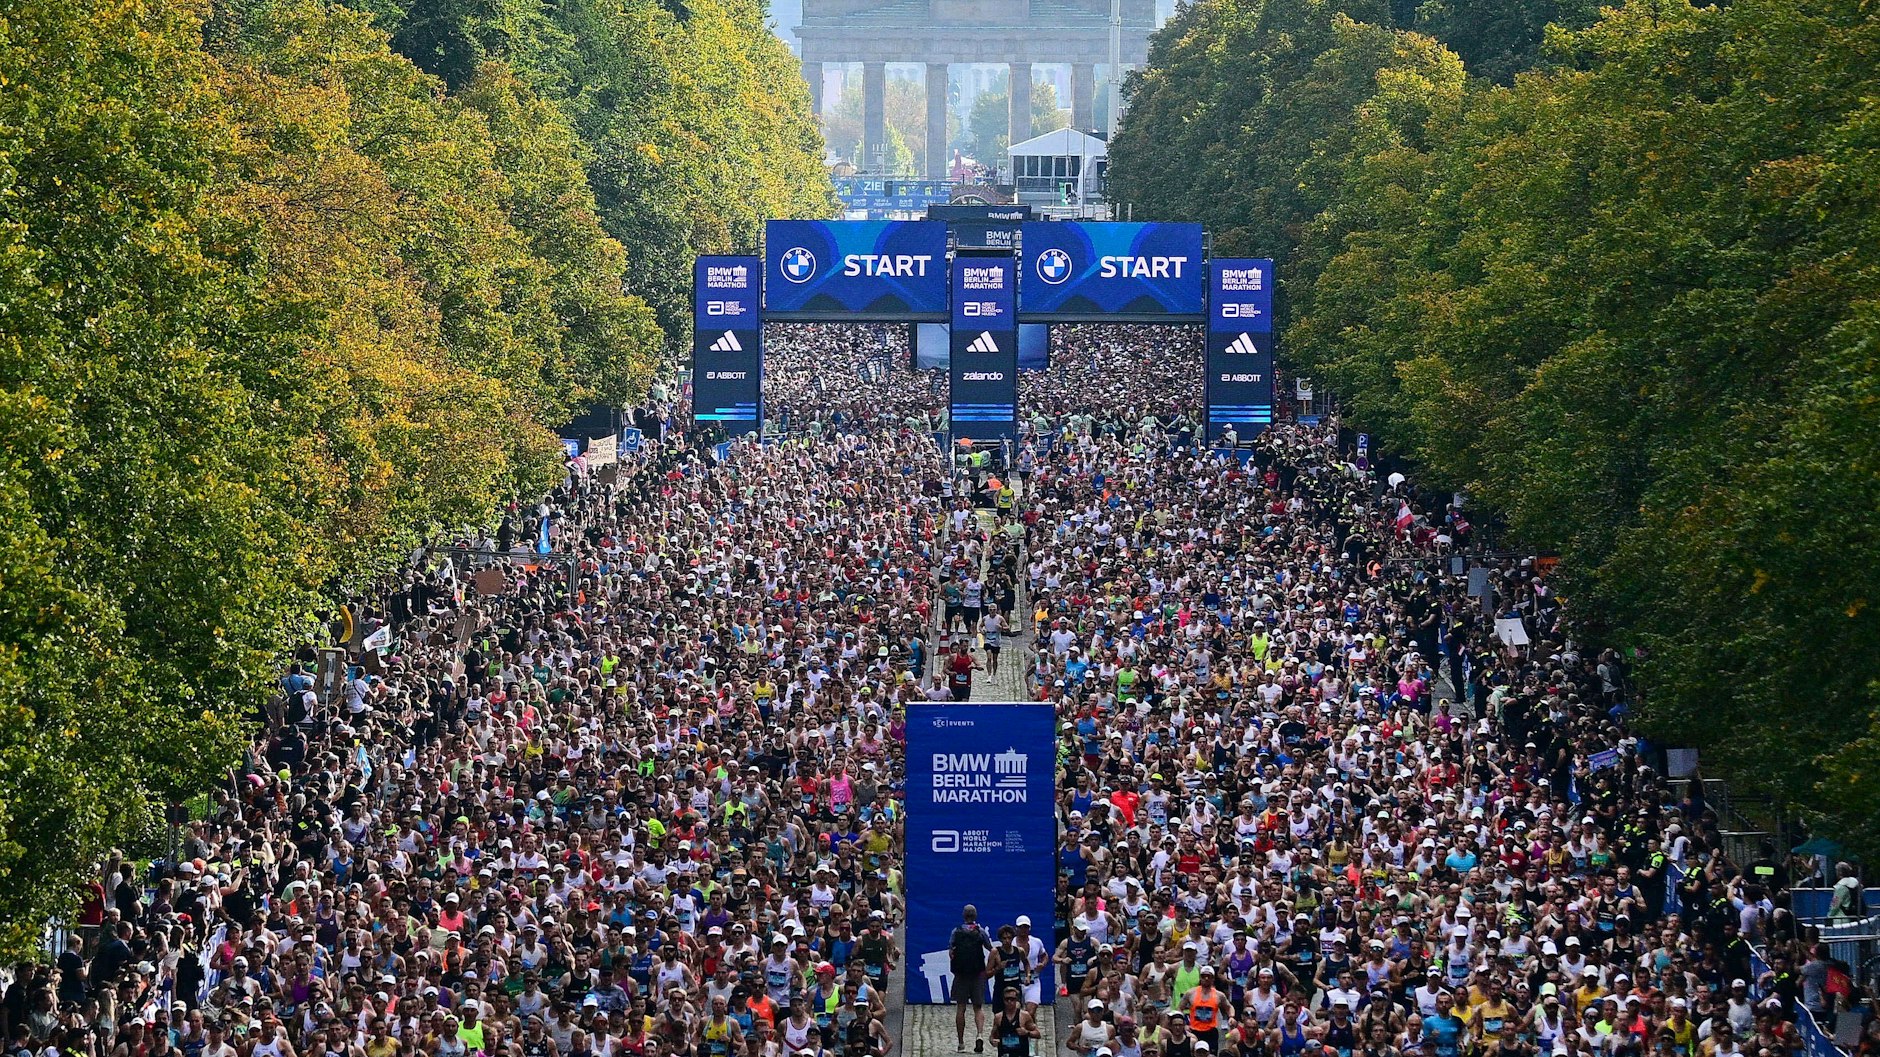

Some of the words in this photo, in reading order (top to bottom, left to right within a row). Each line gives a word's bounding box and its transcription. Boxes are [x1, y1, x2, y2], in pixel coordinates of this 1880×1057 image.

[986, 231, 1012, 240] BMW
[844, 255, 932, 277] START
[1100, 255, 1188, 279] START
[707, 267, 733, 276] BMW
[964, 268, 989, 277] BMW
[1222, 269, 1248, 278] BMW
[716, 372, 746, 380] ABBOTT
[963, 372, 1004, 381] zalando
[1231, 374, 1262, 382] ABBOTT
[933, 754, 990, 771] BMW
[933, 774, 991, 788] BERLIN
[933, 789, 1027, 803] MARATHON
